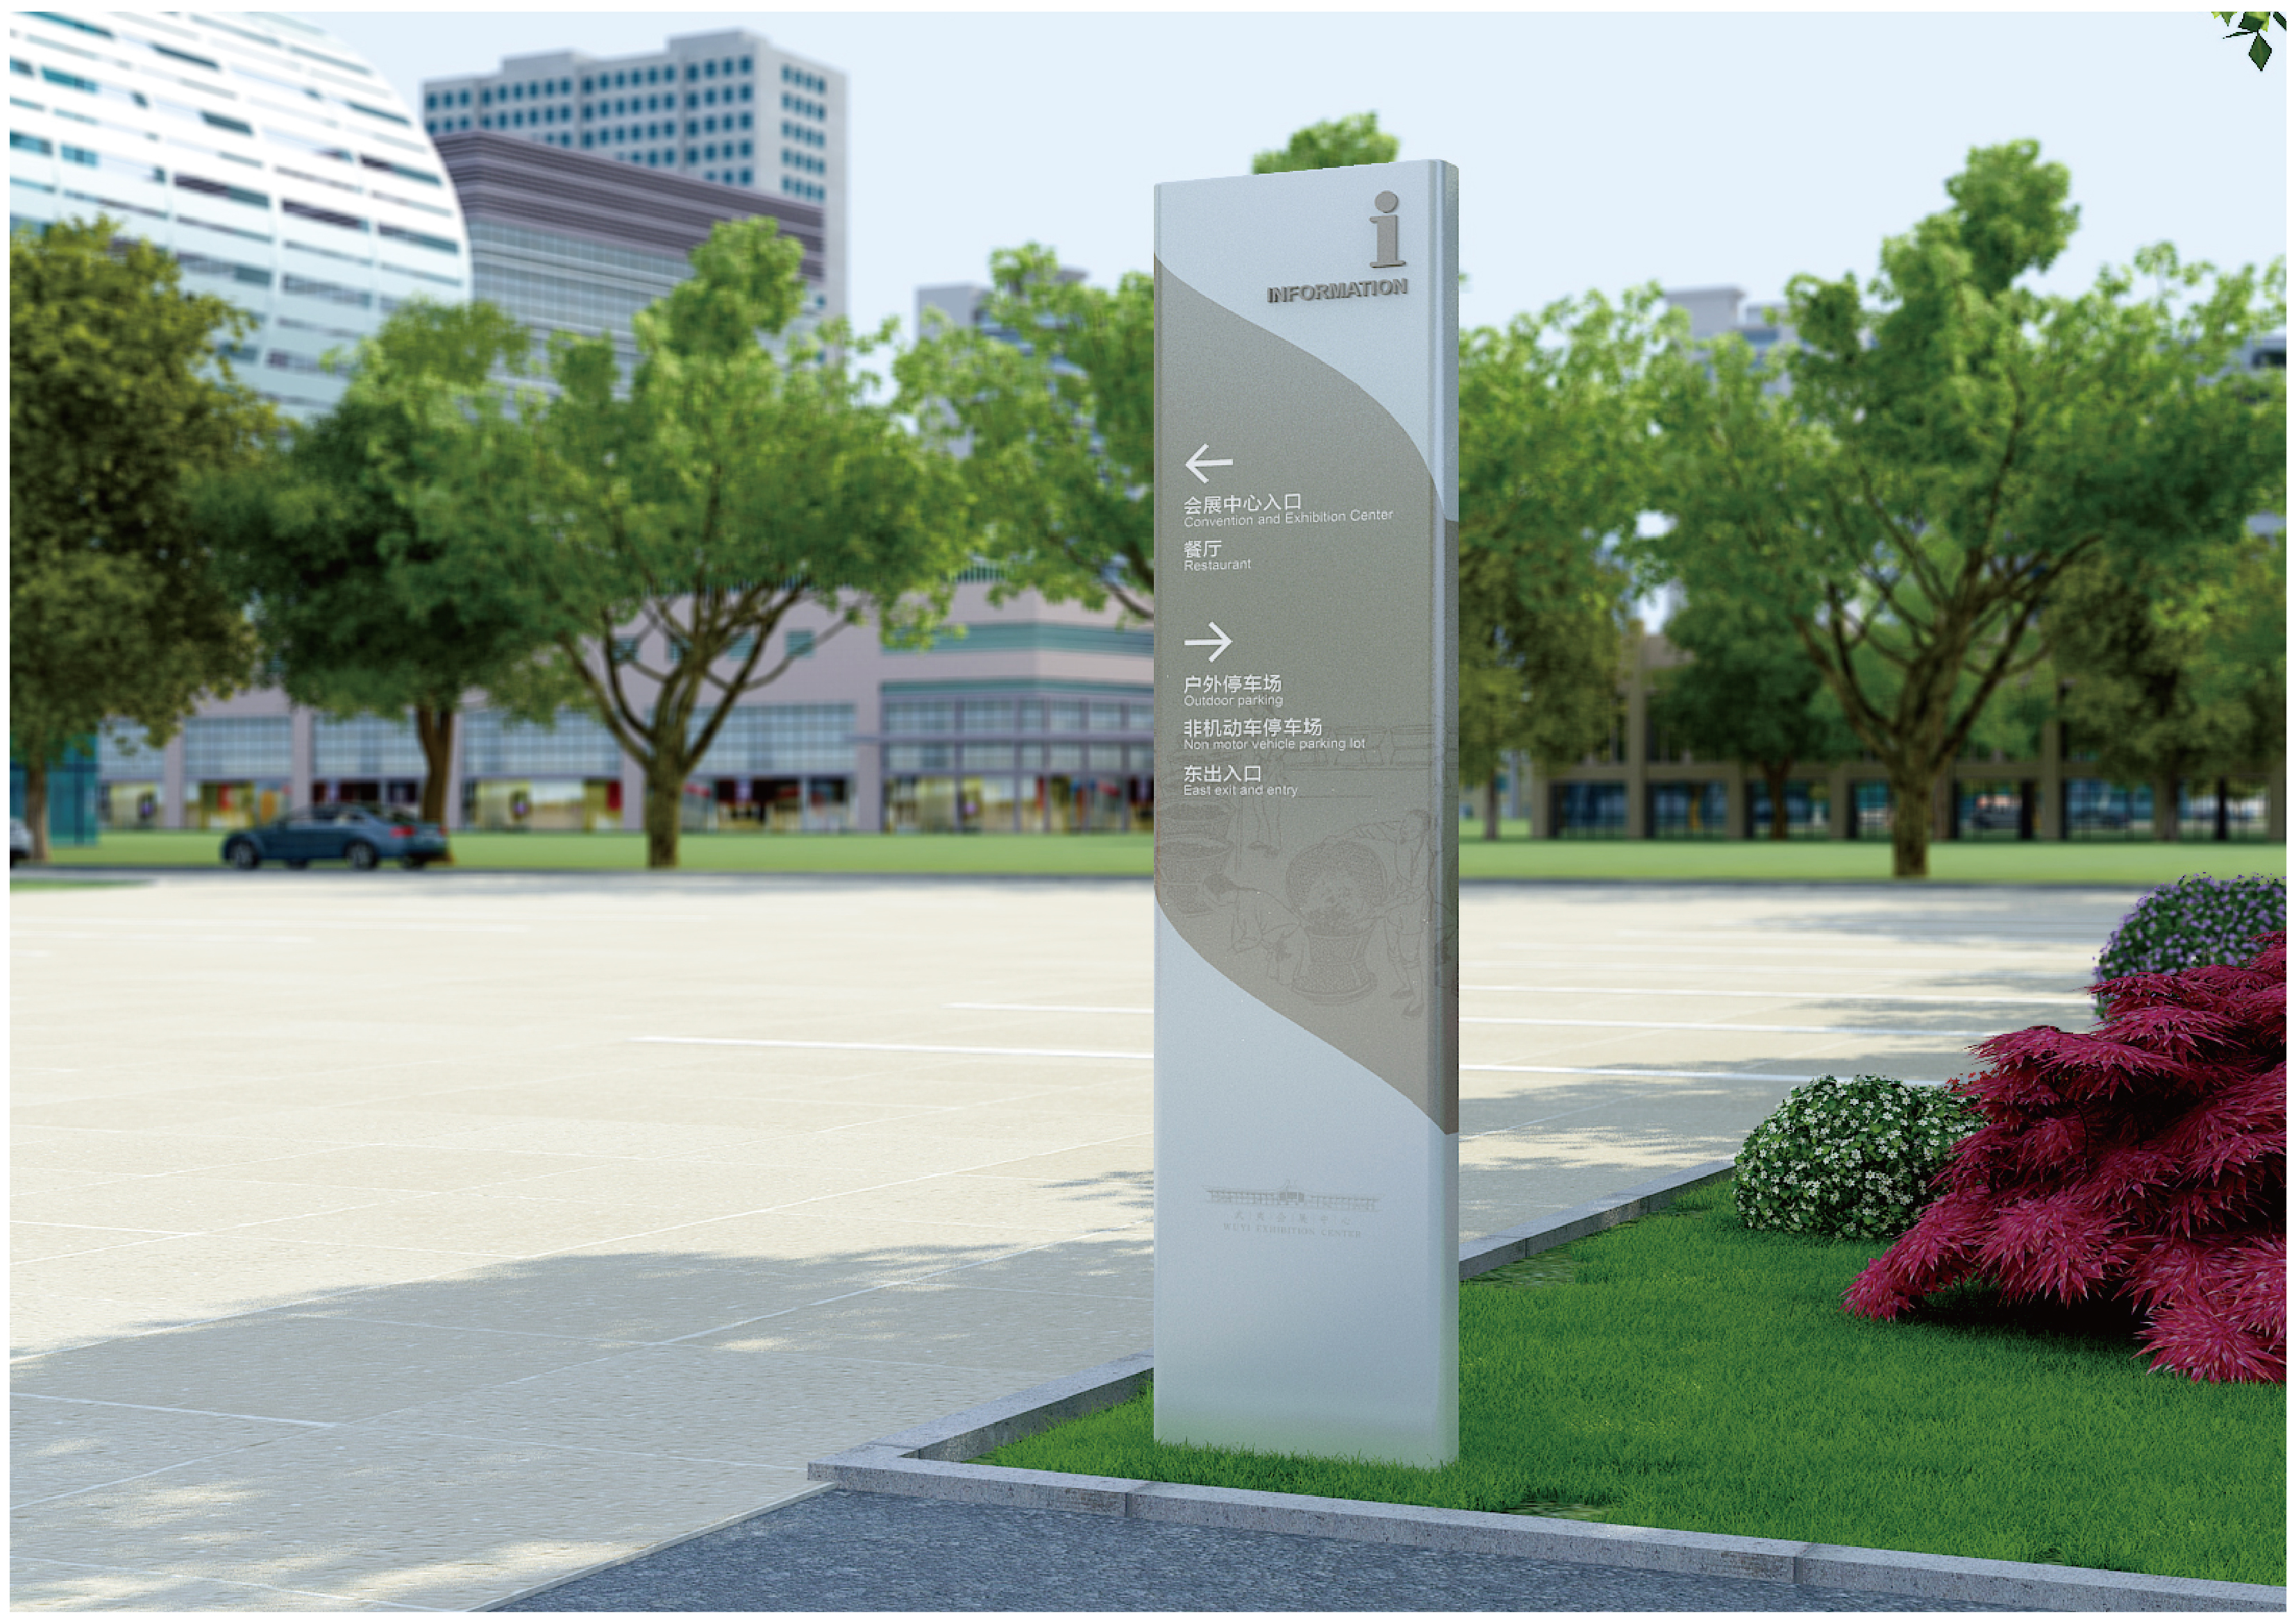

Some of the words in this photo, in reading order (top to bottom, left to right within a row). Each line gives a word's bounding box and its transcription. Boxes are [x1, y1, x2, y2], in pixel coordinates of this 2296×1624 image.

[1267, 278, 1408, 303] INFORMATION
[1184, 493, 1302, 514] 会展中心入口
[1184, 515, 1253, 528] Convention
[1257, 514, 1280, 525] and
[1284, 511, 1346, 524] Exhibition
[1350, 509, 1393, 522] Center
[1184, 540, 1222, 558] 餐厅
[1184, 558, 1251, 571] Restaurant
[1184, 674, 1282, 694] 户外停车场
[1184, 695, 1235, 707] Outdoor
[1237, 695, 1284, 708] parking
[1184, 717, 1323, 737] 非机动车停车场
[1184, 739, 1210, 751] Non
[1213, 739, 1249, 751] motor
[1252, 738, 1296, 750] vehicle
[1299, 738, 1346, 751] parking
[1349, 737, 1366, 748] lot
[1184, 764, 1262, 782] 东出入口
[1184, 785, 1211, 796] East
[1214, 785, 1237, 796] exit
[1240, 785, 1264, 796] and
[1267, 786, 1298, 798] entry
